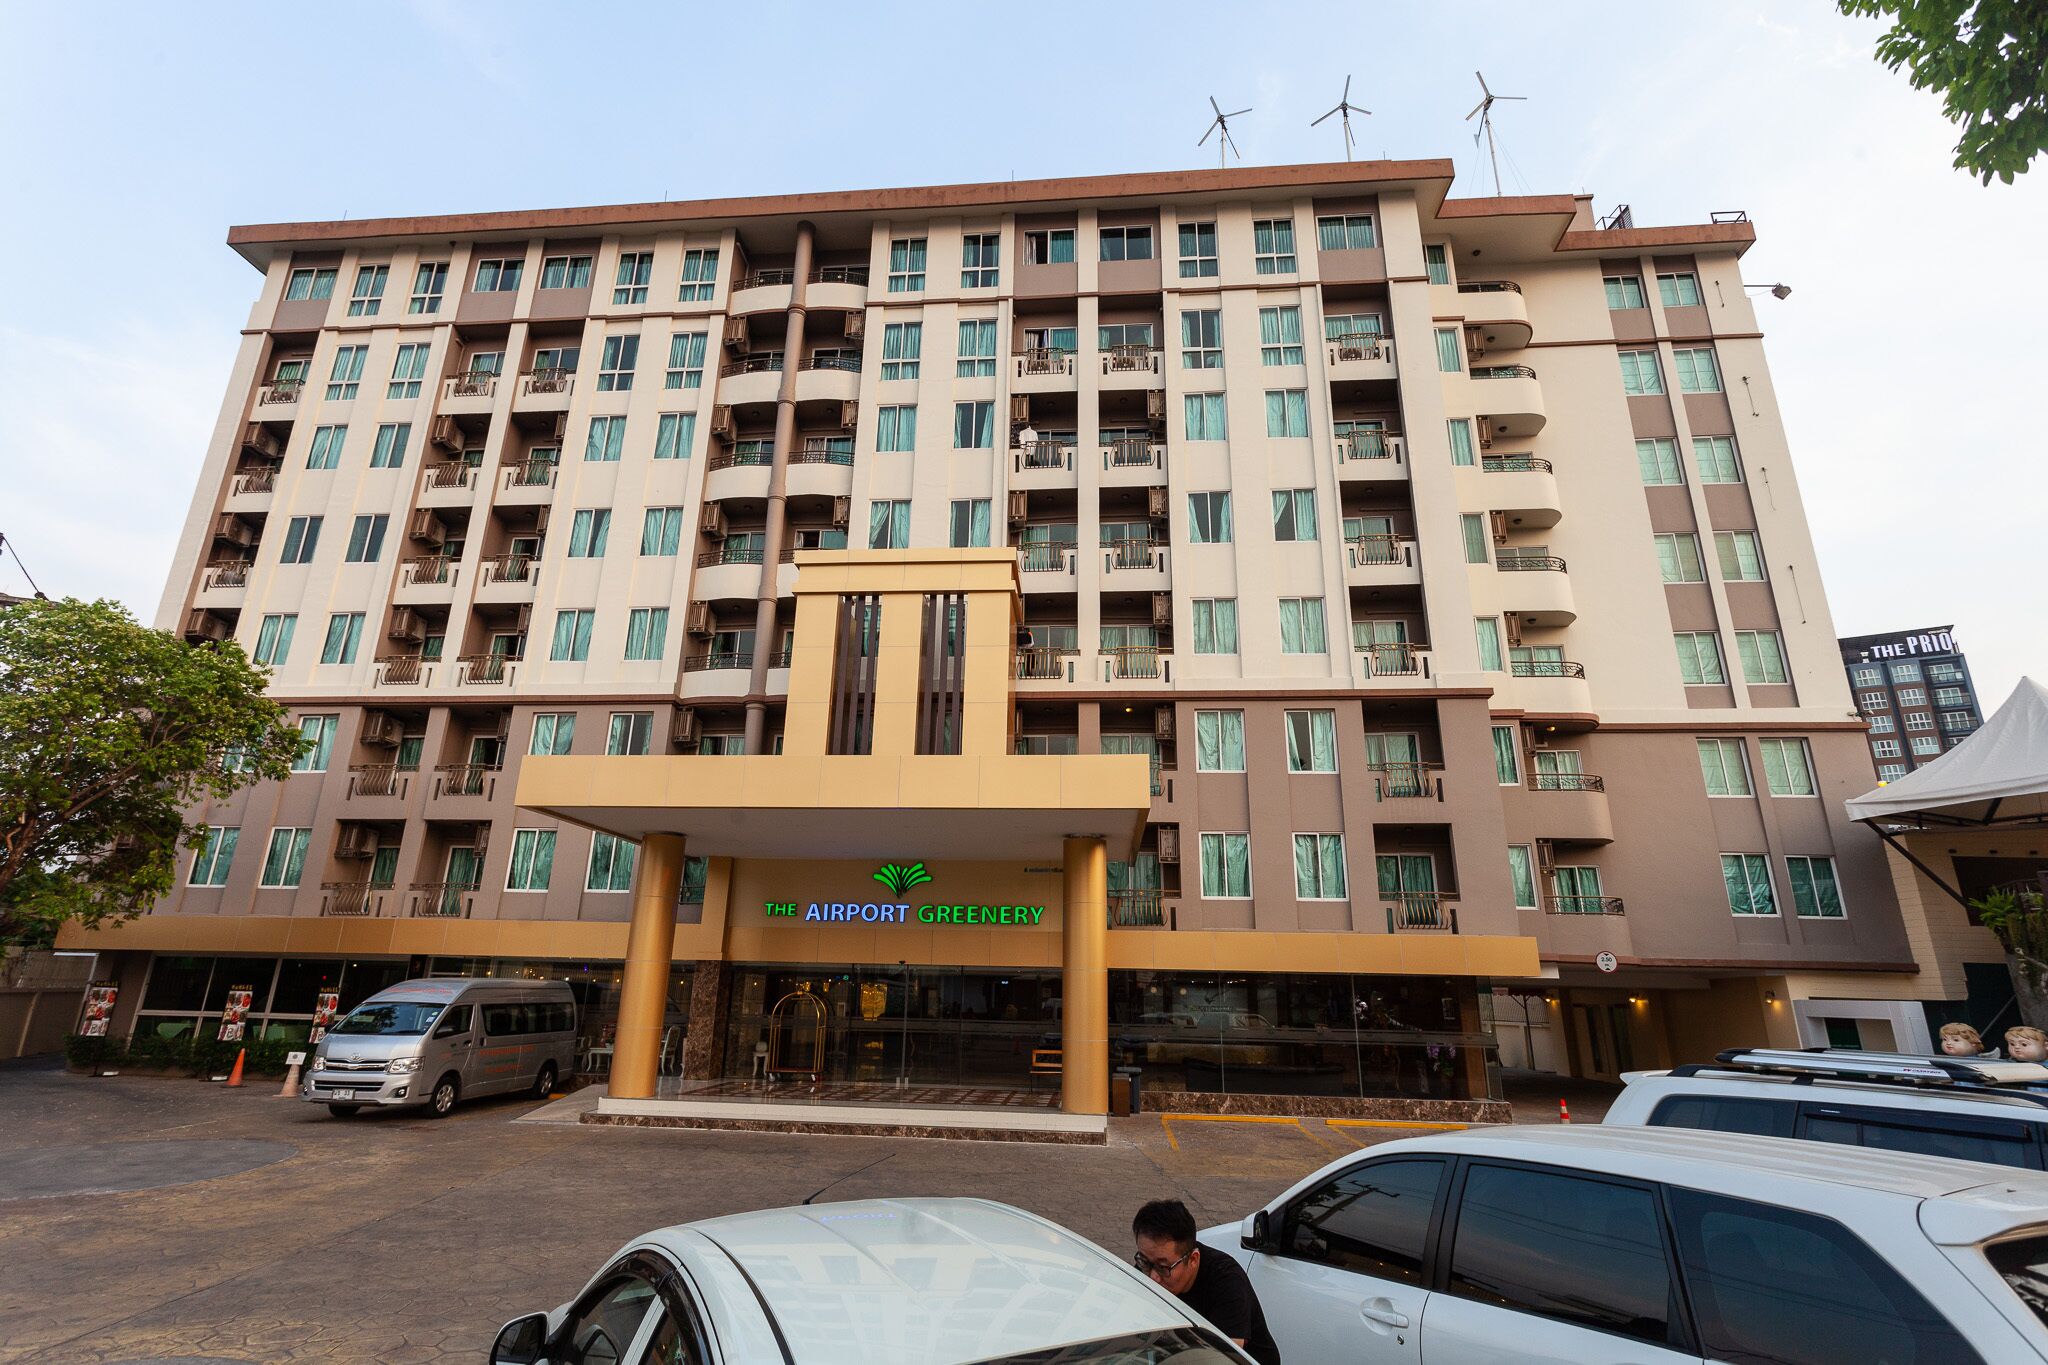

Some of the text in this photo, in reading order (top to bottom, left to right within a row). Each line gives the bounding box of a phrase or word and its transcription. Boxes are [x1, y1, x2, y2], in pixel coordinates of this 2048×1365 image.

[1870, 632, 1953, 659] THE PRIO
[764, 903, 1045, 925] THE AIRPORT GREENERY
